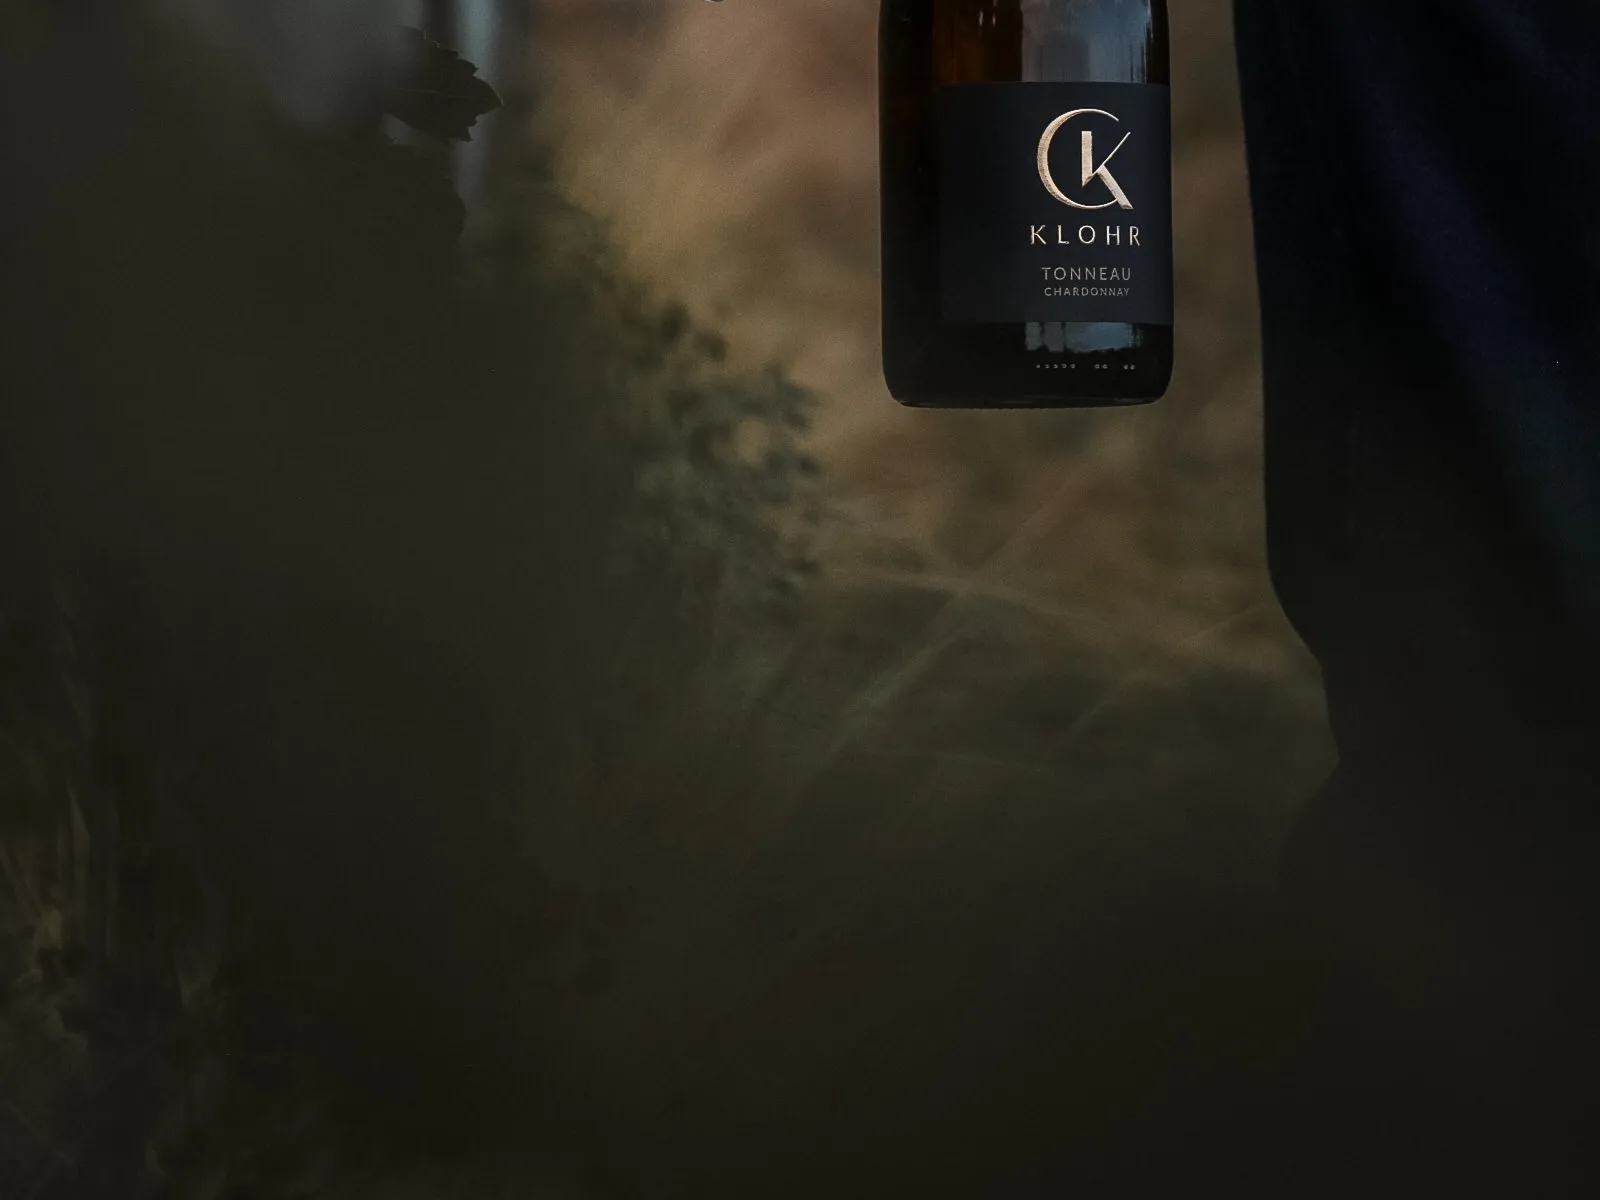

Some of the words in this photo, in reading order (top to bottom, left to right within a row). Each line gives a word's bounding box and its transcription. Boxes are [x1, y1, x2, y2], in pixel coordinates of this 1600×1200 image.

[1030, 224, 1141, 247] KLOHR
[1041, 266, 1132, 281] TONNEAU
[1043, 287, 1130, 297] CHARDONNAY
